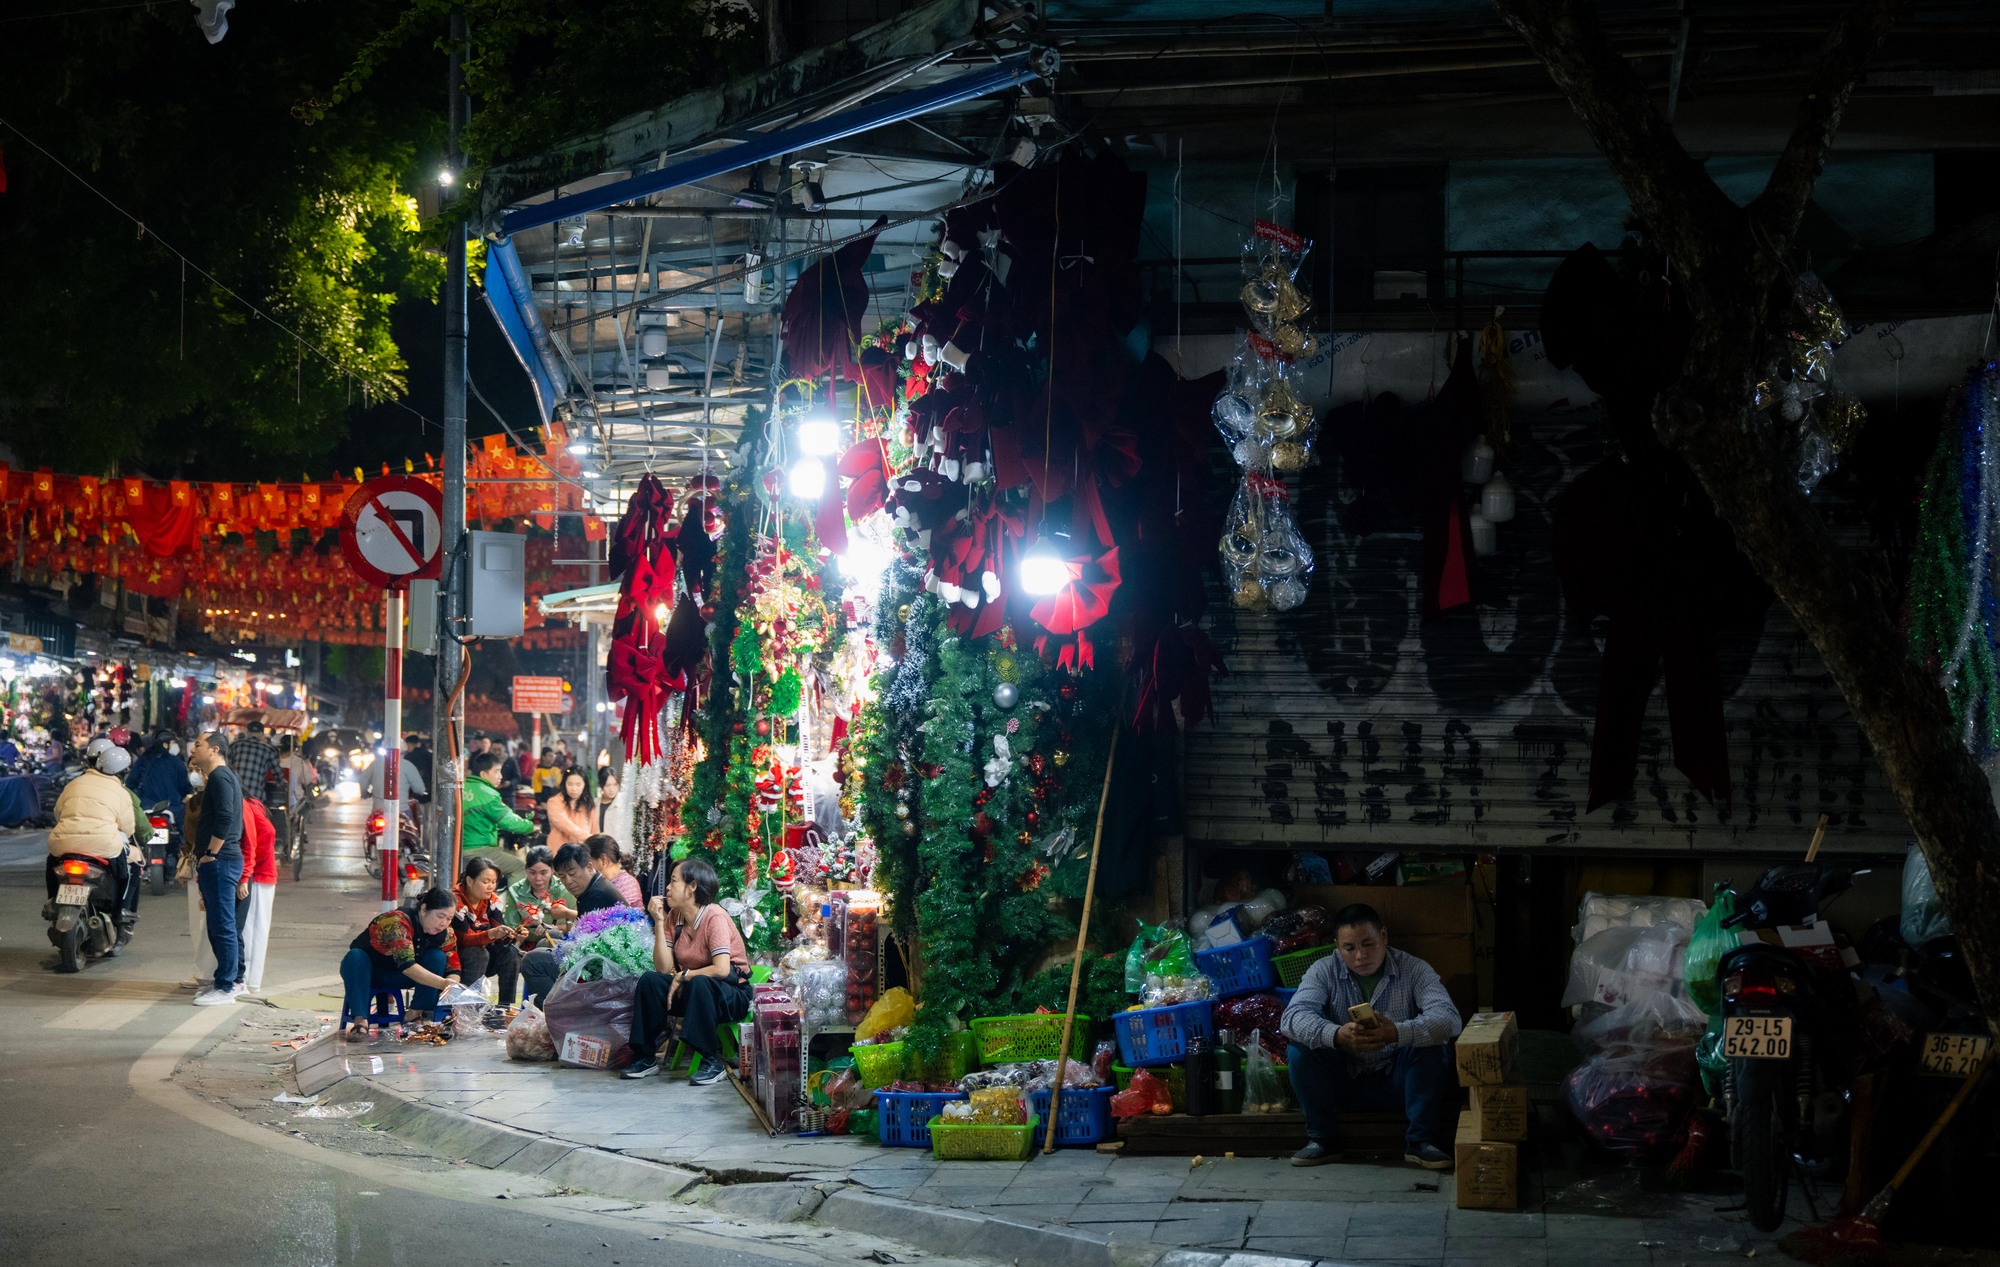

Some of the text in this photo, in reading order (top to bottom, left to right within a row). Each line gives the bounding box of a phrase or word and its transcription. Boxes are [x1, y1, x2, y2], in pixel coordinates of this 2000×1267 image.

[1735, 1019, 1783, 1037] 29-L5
[1727, 1037, 1788, 1056] 542.00
[1931, 1036, 1977, 1055] 36-F1
